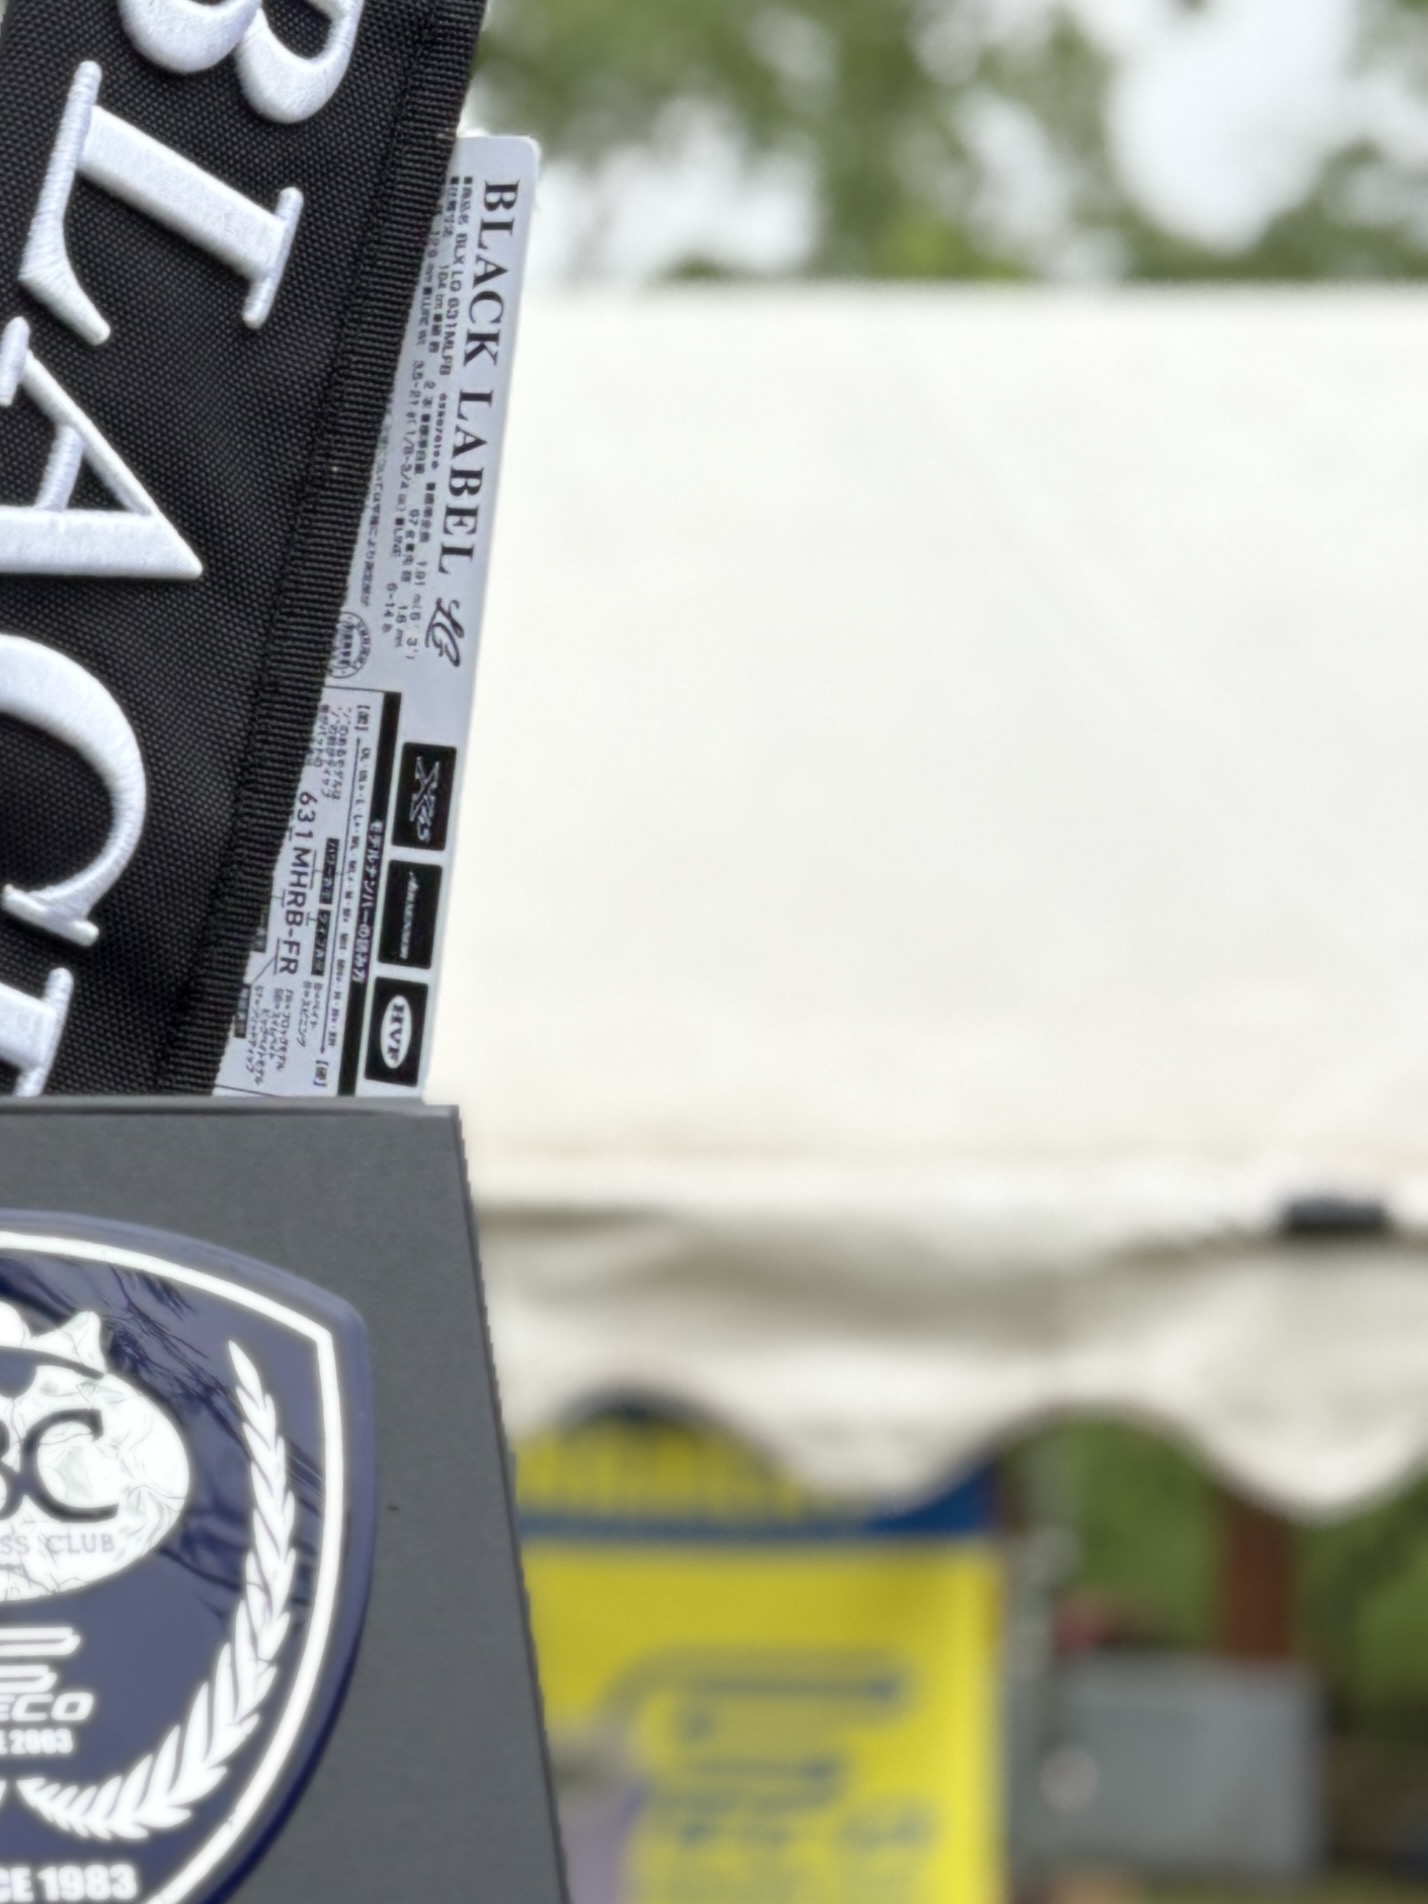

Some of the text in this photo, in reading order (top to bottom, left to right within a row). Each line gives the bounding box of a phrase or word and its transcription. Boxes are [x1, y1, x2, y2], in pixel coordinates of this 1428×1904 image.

[461, 176, 519, 369] BLACK
[436, 389, 493, 578] LABEL
[277, 791, 319, 975] 631MHRB-FR
[385, 1003, 405, 1064] HVF
[46, 1533, 116, 1555] CLUB
[37, 1862, 138, 1902] 1983
